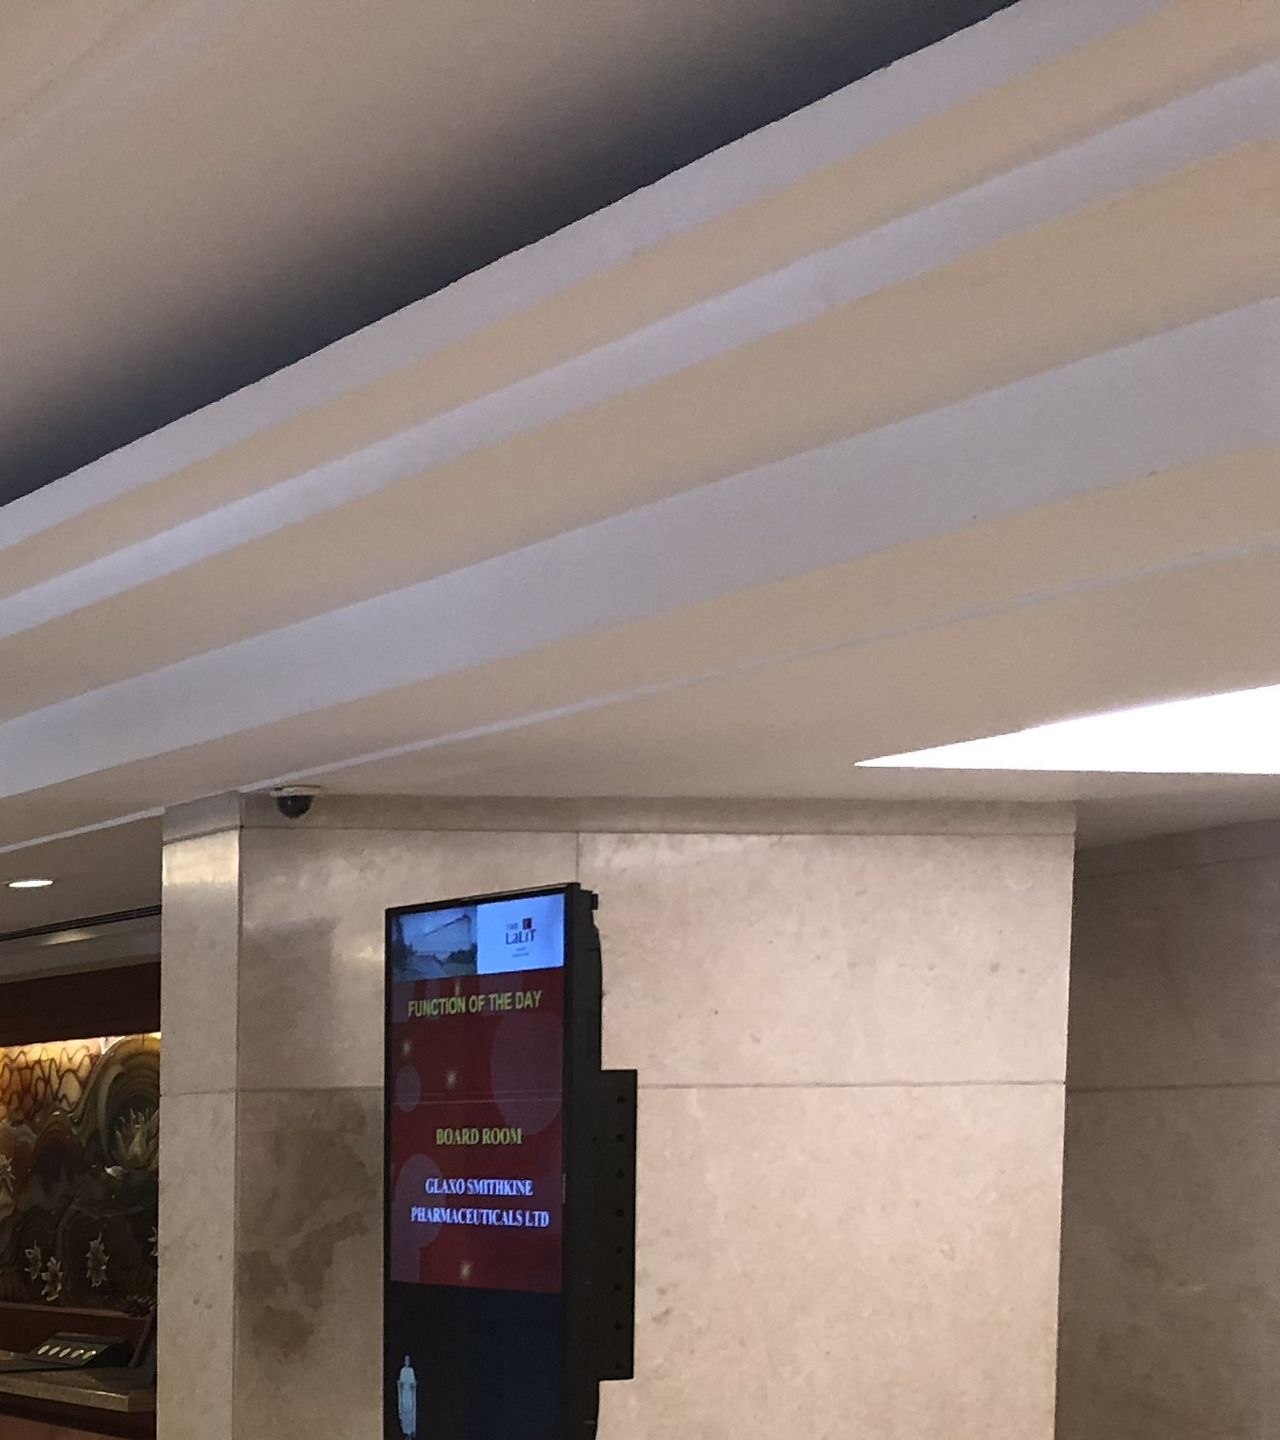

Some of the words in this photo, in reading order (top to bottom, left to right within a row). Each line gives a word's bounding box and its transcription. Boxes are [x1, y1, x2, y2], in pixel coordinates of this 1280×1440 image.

[408, 996, 465, 1017] FUNCTION
[469, 995, 485, 1013] OF
[489, 992, 513, 1011] THE
[515, 990, 542, 1009] DAY
[436, 1128, 480, 1145] BOARD
[482, 1127, 522, 1145] ROOM
[425, 1178, 465, 1195] GLAXO
[467, 1179, 533, 1196] SMITHKINE
[411, 1206, 523, 1227] PHARMACEUTICALS
[525, 1210, 550, 1228] LTD
